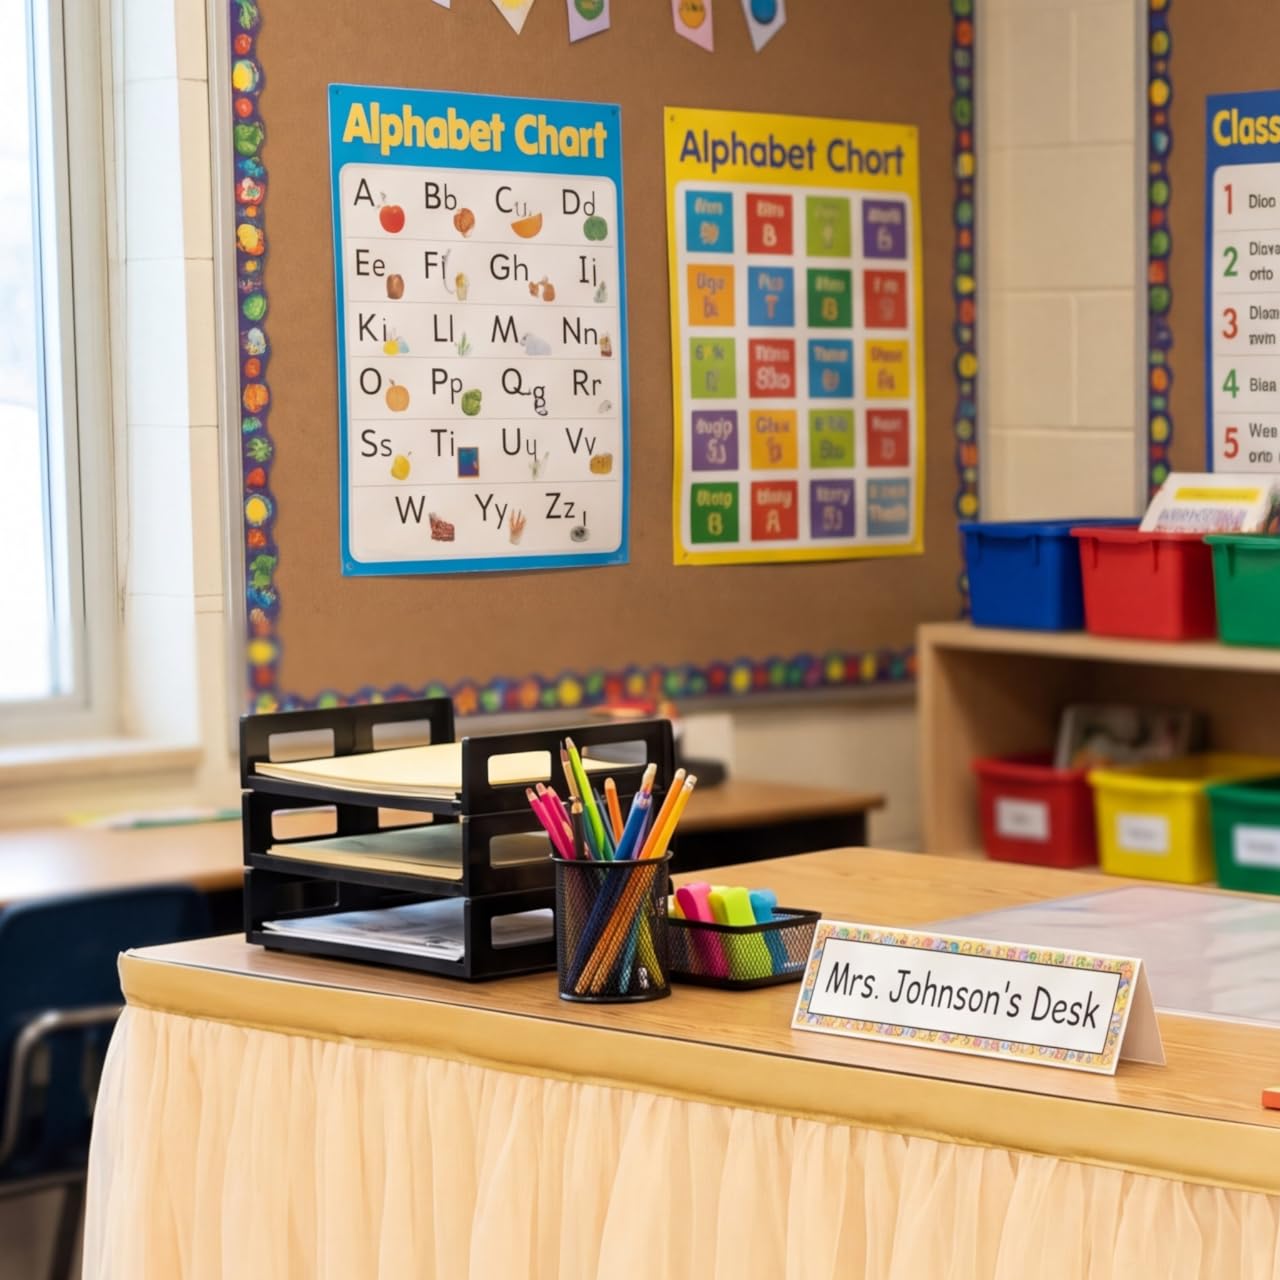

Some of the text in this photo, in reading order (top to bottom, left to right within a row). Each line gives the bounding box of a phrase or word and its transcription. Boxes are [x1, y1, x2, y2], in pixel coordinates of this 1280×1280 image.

[342, 101, 608, 159] Alphabet Chart
[680, 129, 817, 174] Alphabet
[424, 181, 457, 211] Bb
[562, 188, 596, 217] Dd
[1224, 184, 1234, 215] 1
[355, 249, 386, 277] Ee
[490, 253, 529, 281] Gh
[1223, 246, 1239, 277] 2
[491, 315, 519, 344] M
[562, 316, 598, 345] Nn
[1222, 307, 1238, 339] 3
[359, 367, 382, 395] O
[431, 368, 463, 405] Pp
[573, 369, 602, 396] Rr
[1222, 368, 1240, 399] 4
[361, 429, 393, 458] Ss
[430, 428, 455, 457] Ti
[565, 427, 597, 456] Vv
[1223, 427, 1239, 459] 5
[395, 492, 576, 530] W Yy Zz
[825, 961, 1101, 1030] Mrs. Johnson's Desk
